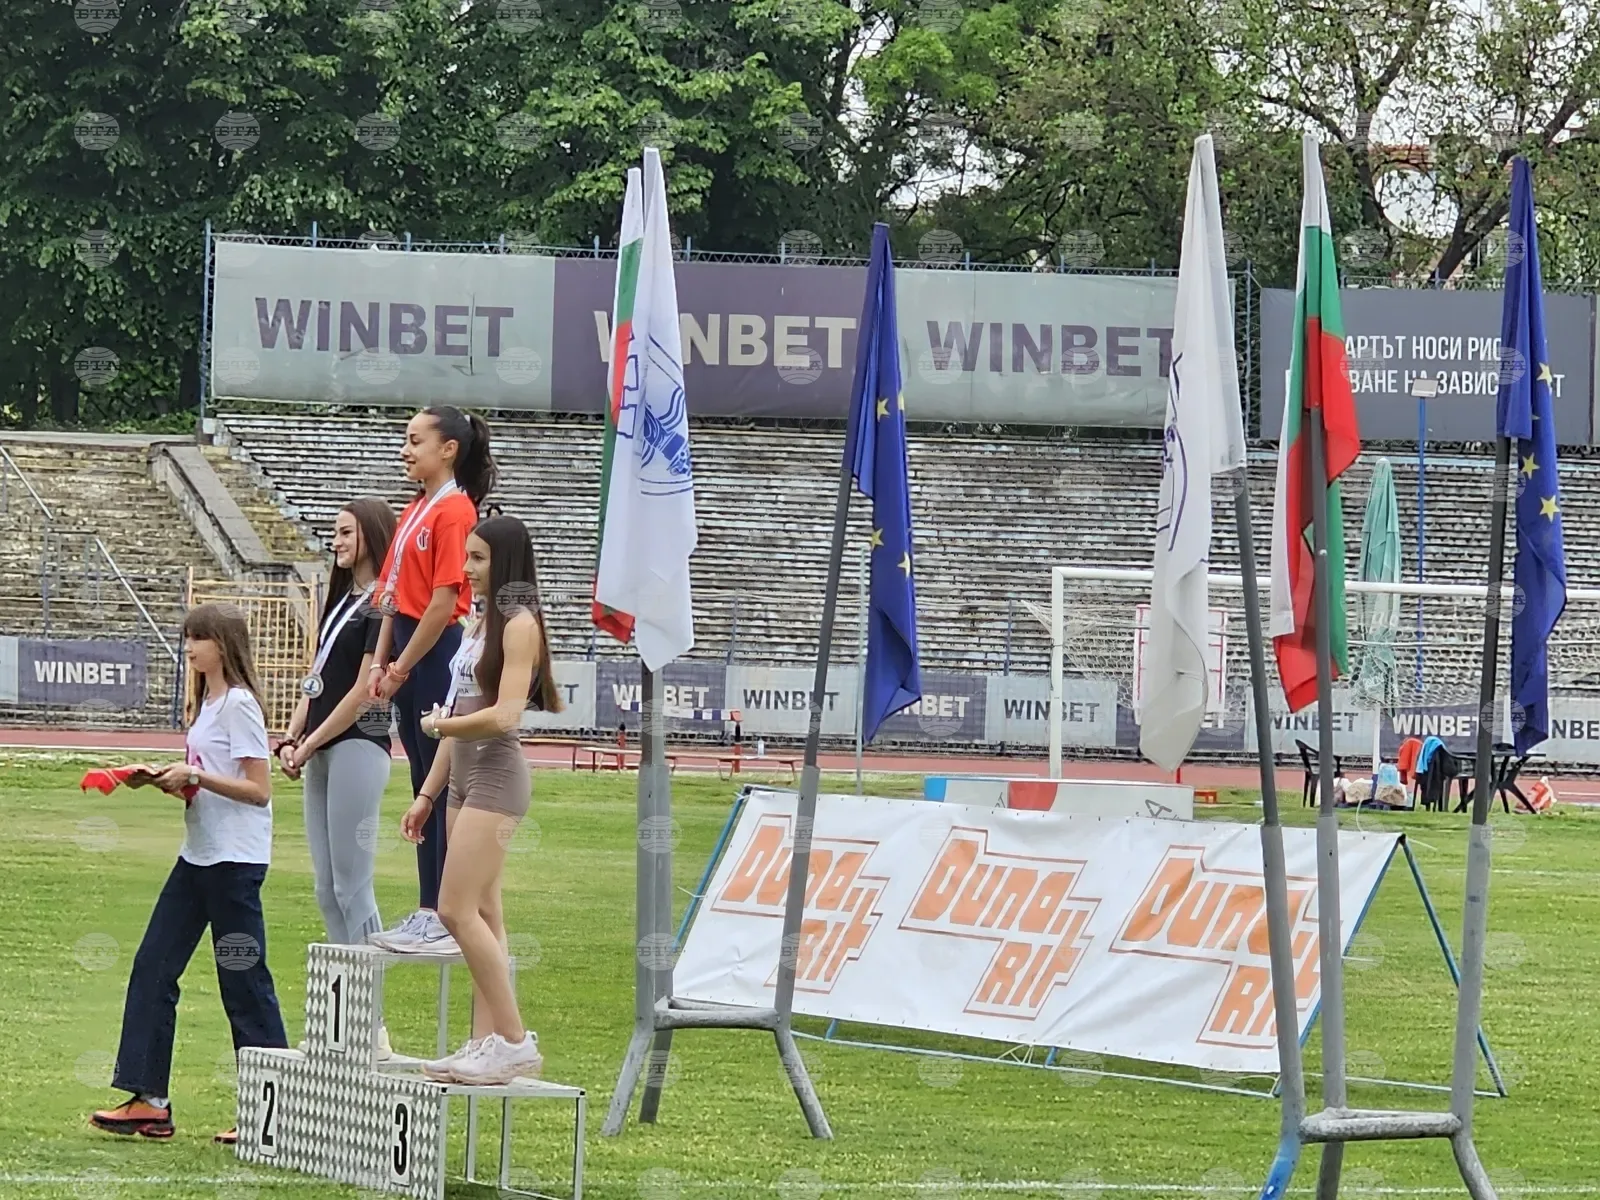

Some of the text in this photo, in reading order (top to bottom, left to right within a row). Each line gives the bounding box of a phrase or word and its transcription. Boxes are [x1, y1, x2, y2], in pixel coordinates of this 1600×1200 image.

[255, 297, 514, 357] WINBET
[593, 310, 857, 368] NBET
[1345, 335, 1502, 361] АРТЪТ НОСИ РИС
[34, 660, 132, 685] WINBET
[612, 684, 710, 708] WIBET
[1551, 719, 1600, 740] NBE
[331, 974, 342, 1043] 1
[261, 1080, 275, 1147] 2
[393, 1102, 409, 1176] 3
